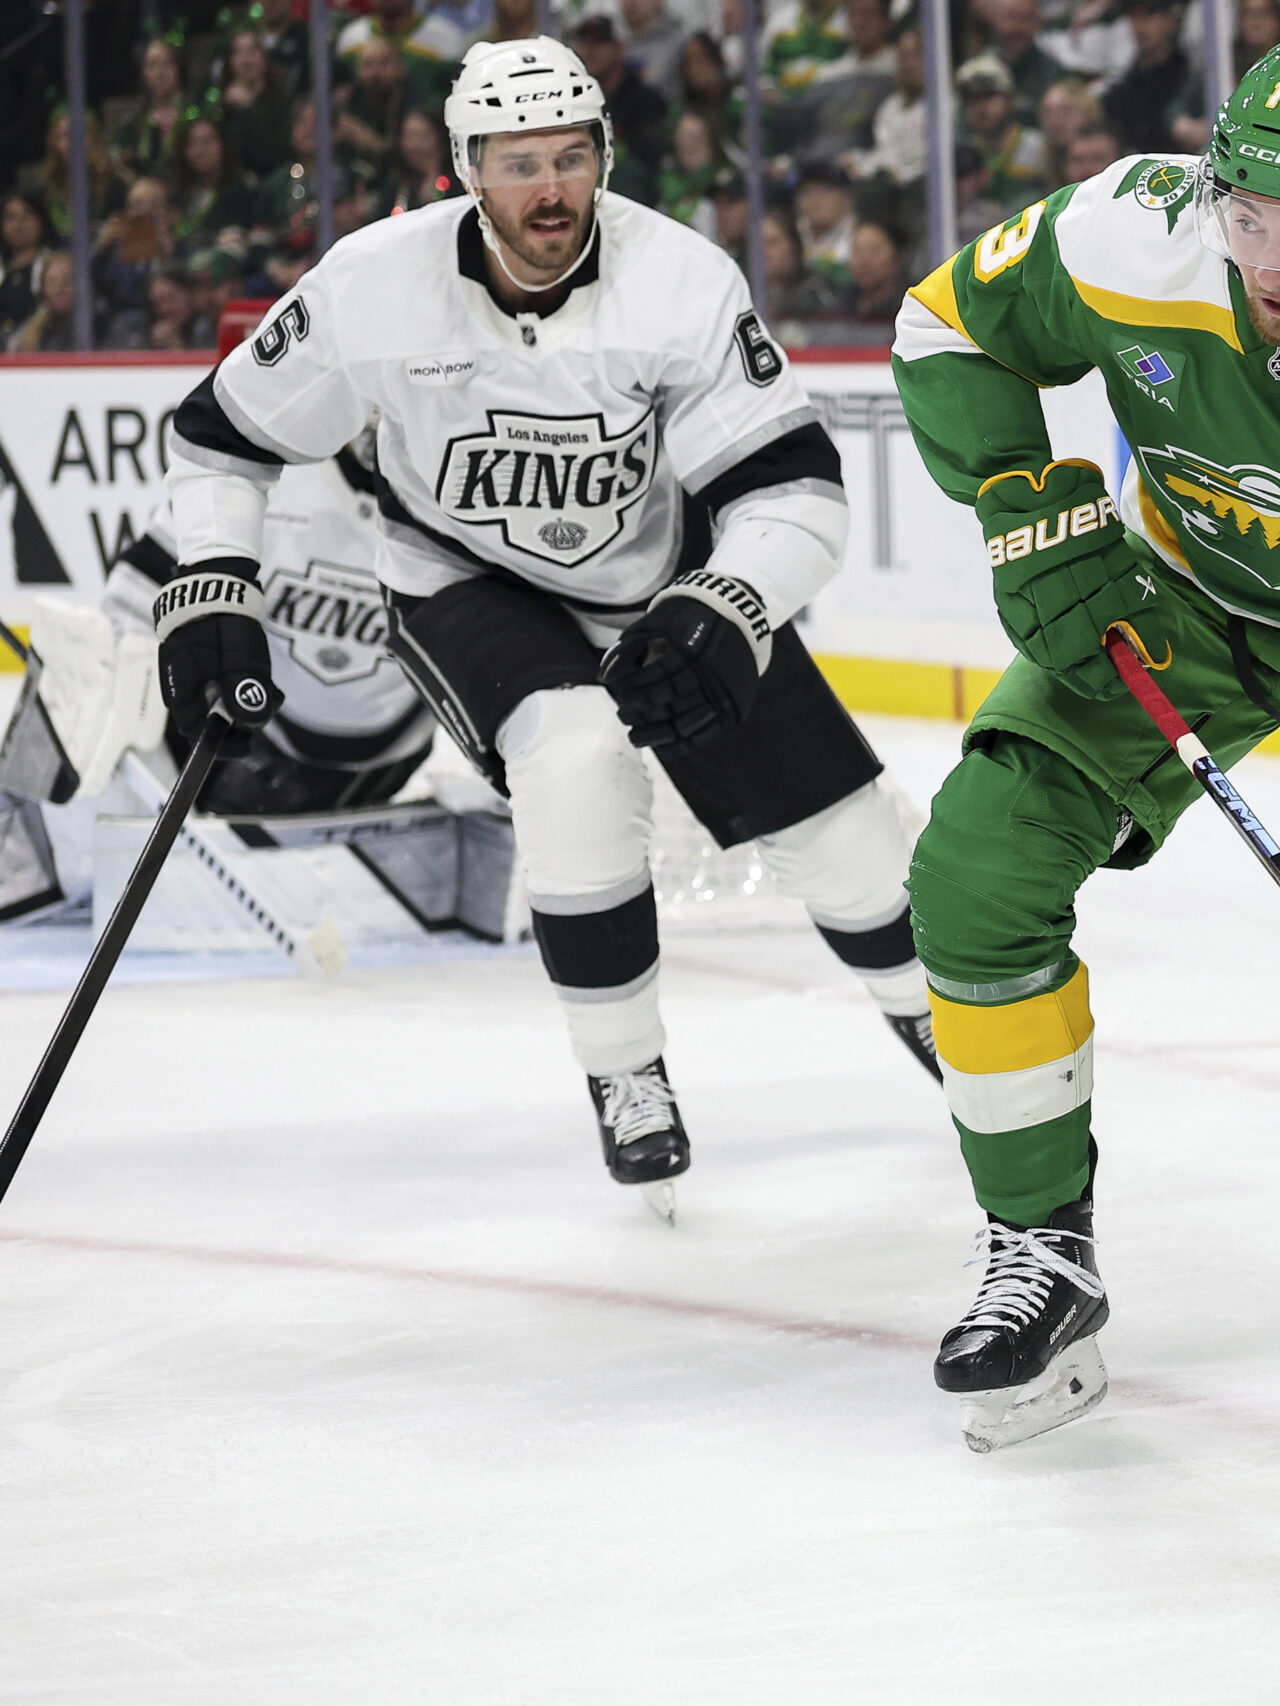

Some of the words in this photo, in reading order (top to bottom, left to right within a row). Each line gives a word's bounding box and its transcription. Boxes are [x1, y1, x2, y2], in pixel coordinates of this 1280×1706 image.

[515, 90, 563, 103] CCM
[974, 200, 1046, 283] 3
[251, 294, 311, 367] 6
[733, 309, 783, 388] 6
[409, 362, 441, 377] IRON
[446, 361, 474, 374] BOW
[506, 426, 531, 441] Los
[533, 428, 589, 446] Angeles
[454, 429, 649, 510] KINGS
[269, 583, 387, 646] KING
[1049, 1303, 1077, 1345] BAUER
